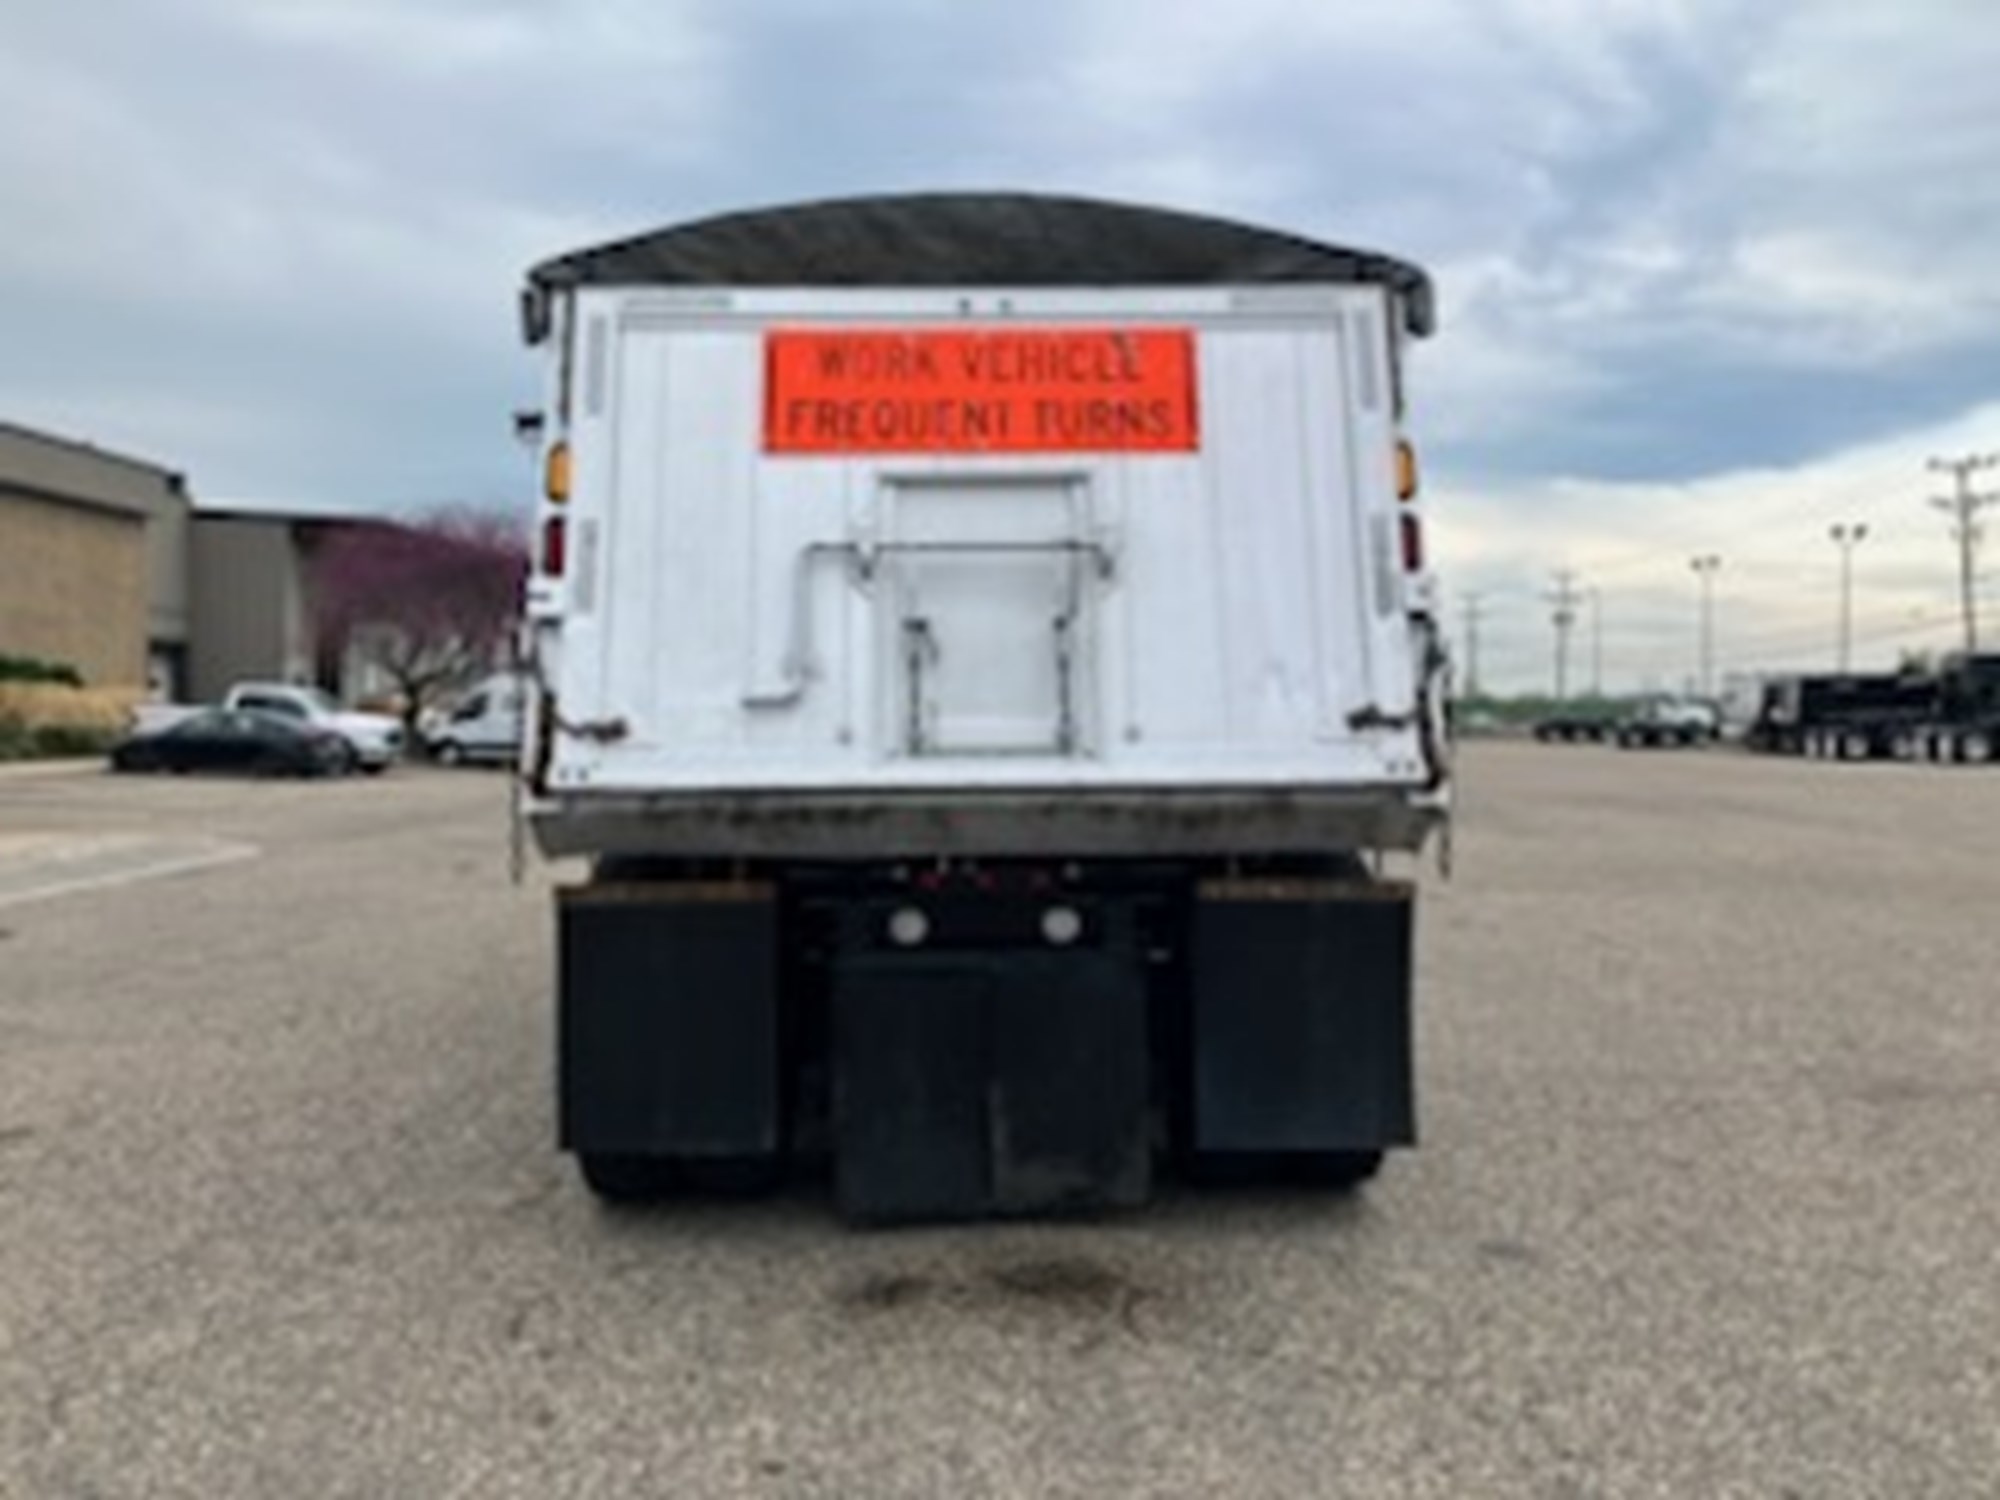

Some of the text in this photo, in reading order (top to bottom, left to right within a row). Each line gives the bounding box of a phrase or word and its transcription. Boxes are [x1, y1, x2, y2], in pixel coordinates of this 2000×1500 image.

[817, 342, 1143, 383] WORK VEHICLE
[785, 399, 1171, 440] FREQUENT TURNS
